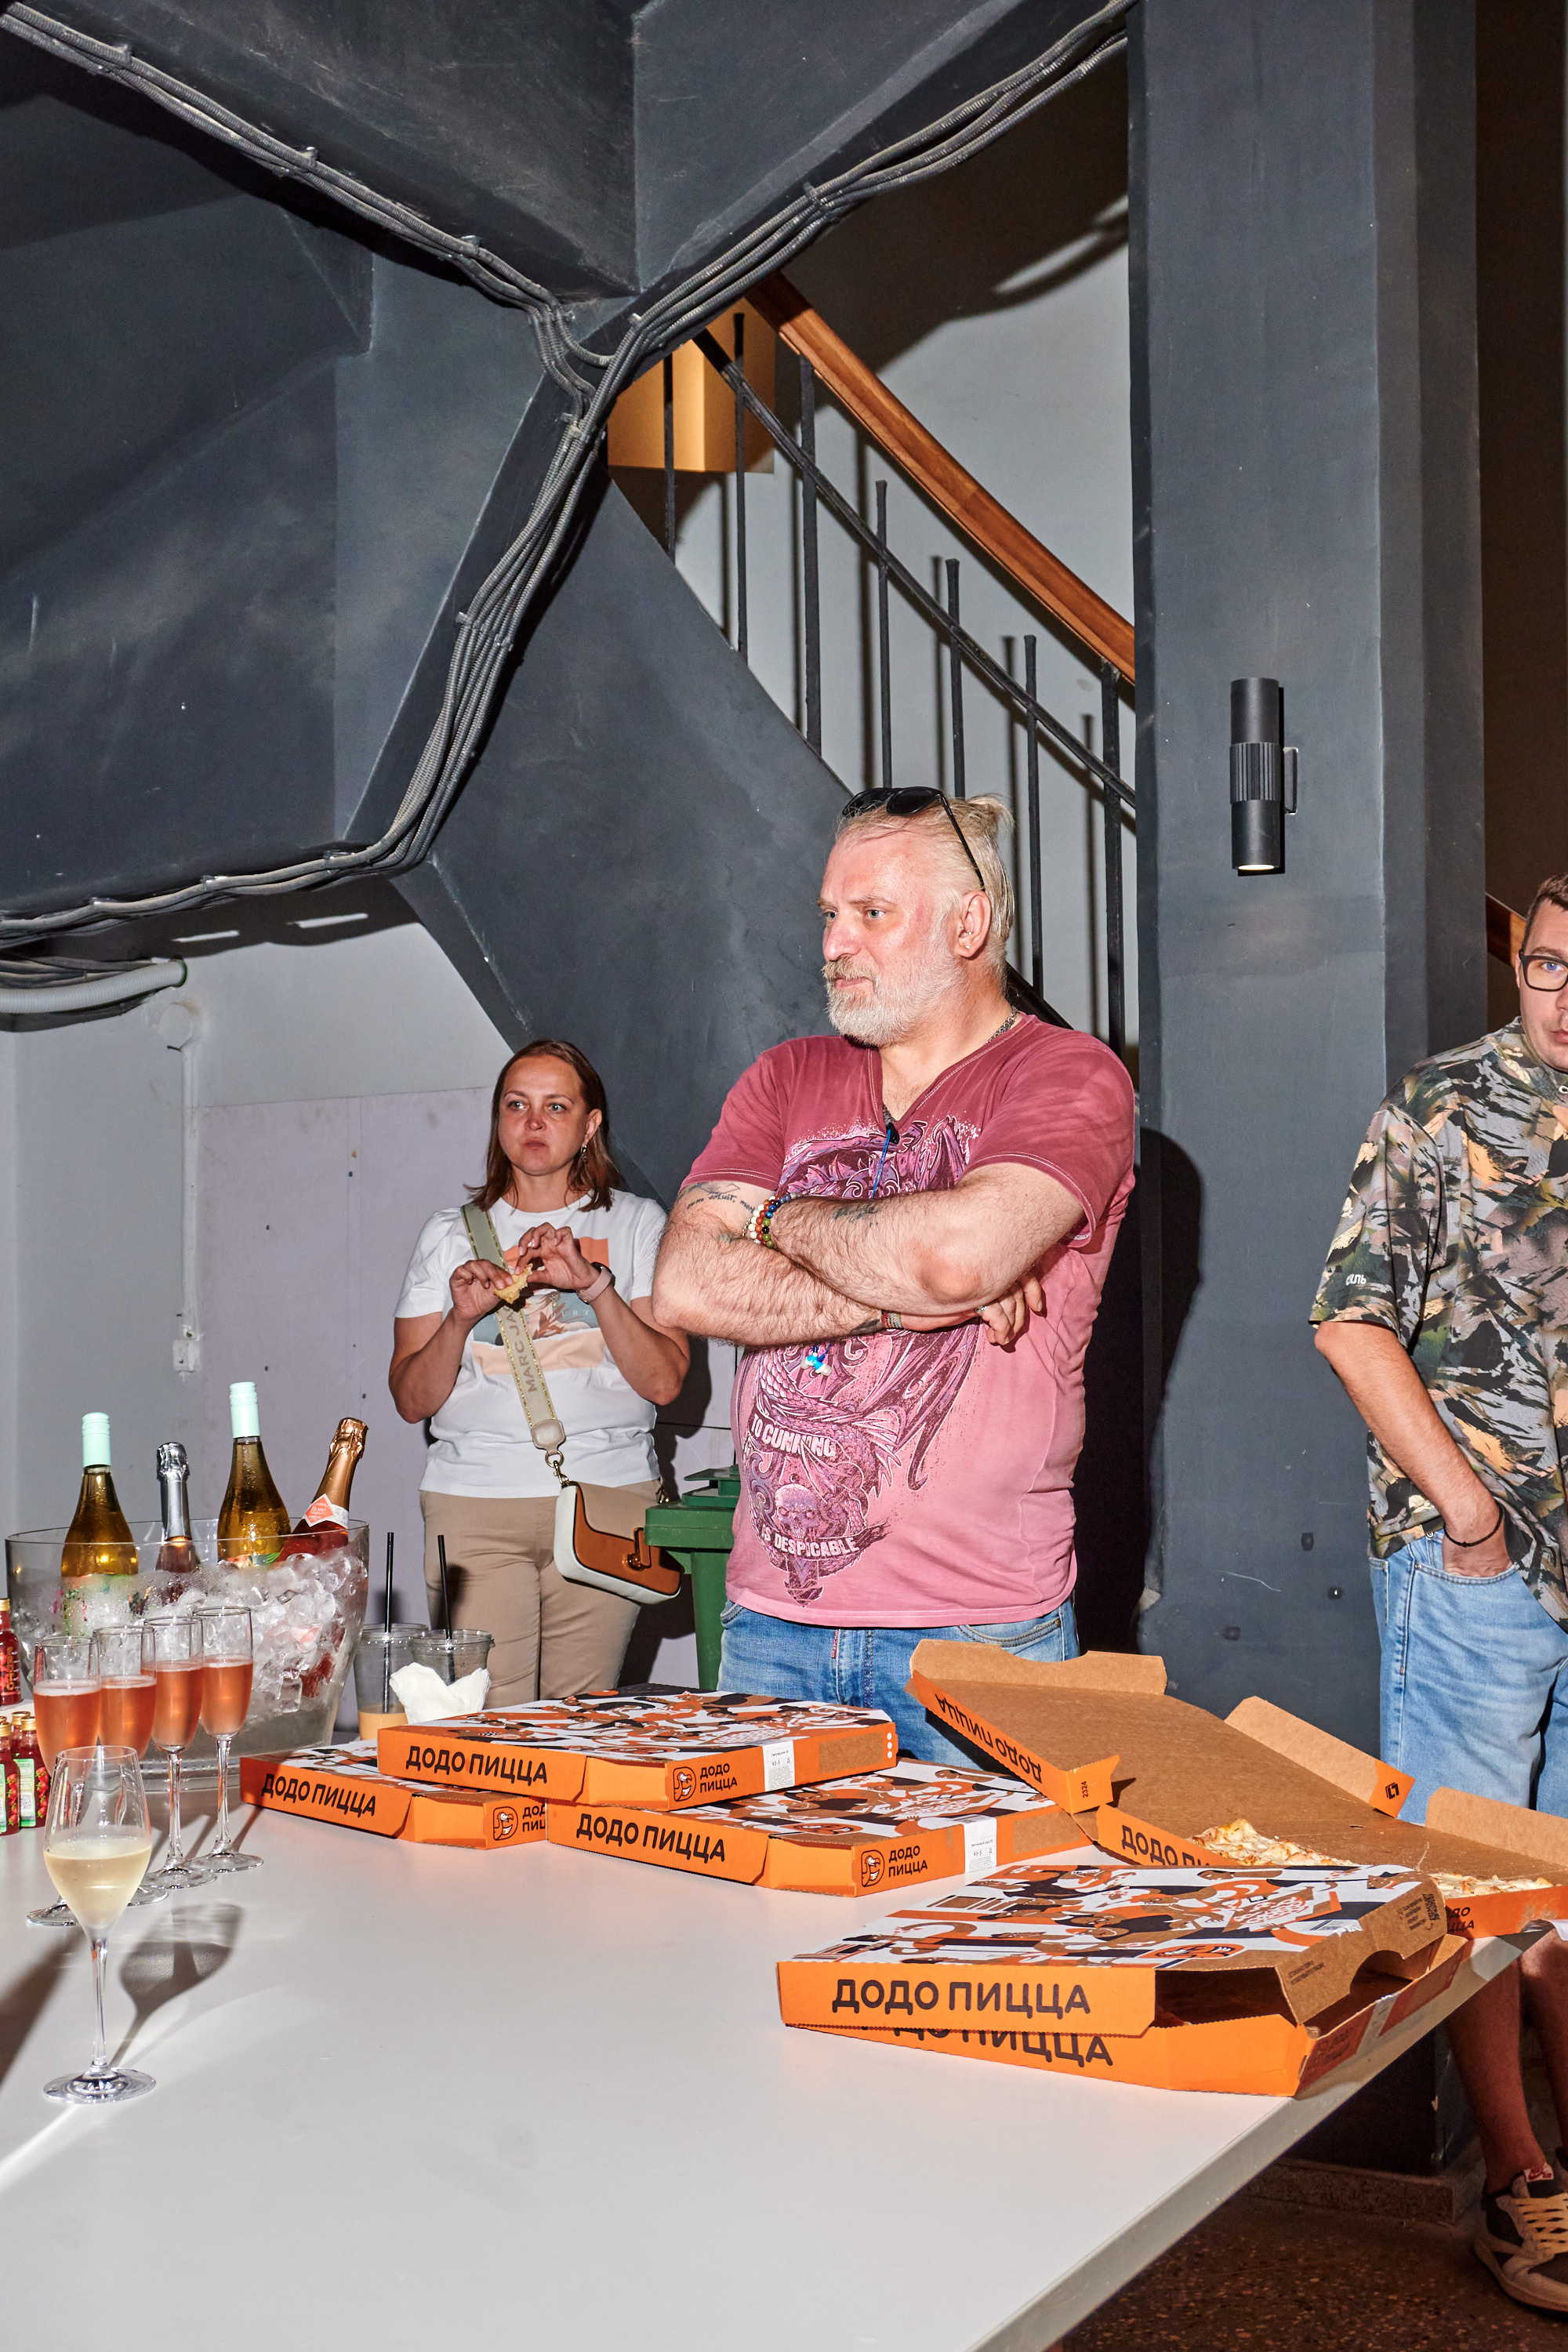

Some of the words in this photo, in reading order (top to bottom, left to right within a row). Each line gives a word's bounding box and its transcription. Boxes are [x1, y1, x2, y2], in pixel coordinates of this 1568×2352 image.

[514, 1341, 537, 1393] MARC
[774, 1533, 860, 1557] DESPICABLE
[935, 1693, 994, 1749] ПИЦЦА
[406, 1745, 466, 1776] ДОДО
[470, 1753, 547, 1787] ПИЦЦА
[700, 1763, 730, 1780] ДОДО
[995, 1737, 1042, 1784] ДОДО
[261, 1773, 310, 1804] ДОДО
[311, 1784, 376, 1818] ПИЦЦА
[700, 1777, 738, 1793] ПИЦЦА
[522, 1804, 545, 1820] ДОД
[522, 1819, 545, 1833] ПИЦ
[576, 1813, 639, 1847] ДОДО
[643, 1825, 725, 1864] ПИЦЦА
[888, 1845, 920, 1864] ДОДО
[1122, 1824, 1178, 1866] ДОДО
[888, 1860, 927, 1878] ПИЦЦА
[832, 1979, 939, 2016] ДОДО
[949, 1981, 1091, 2020] ПИЦЦА
